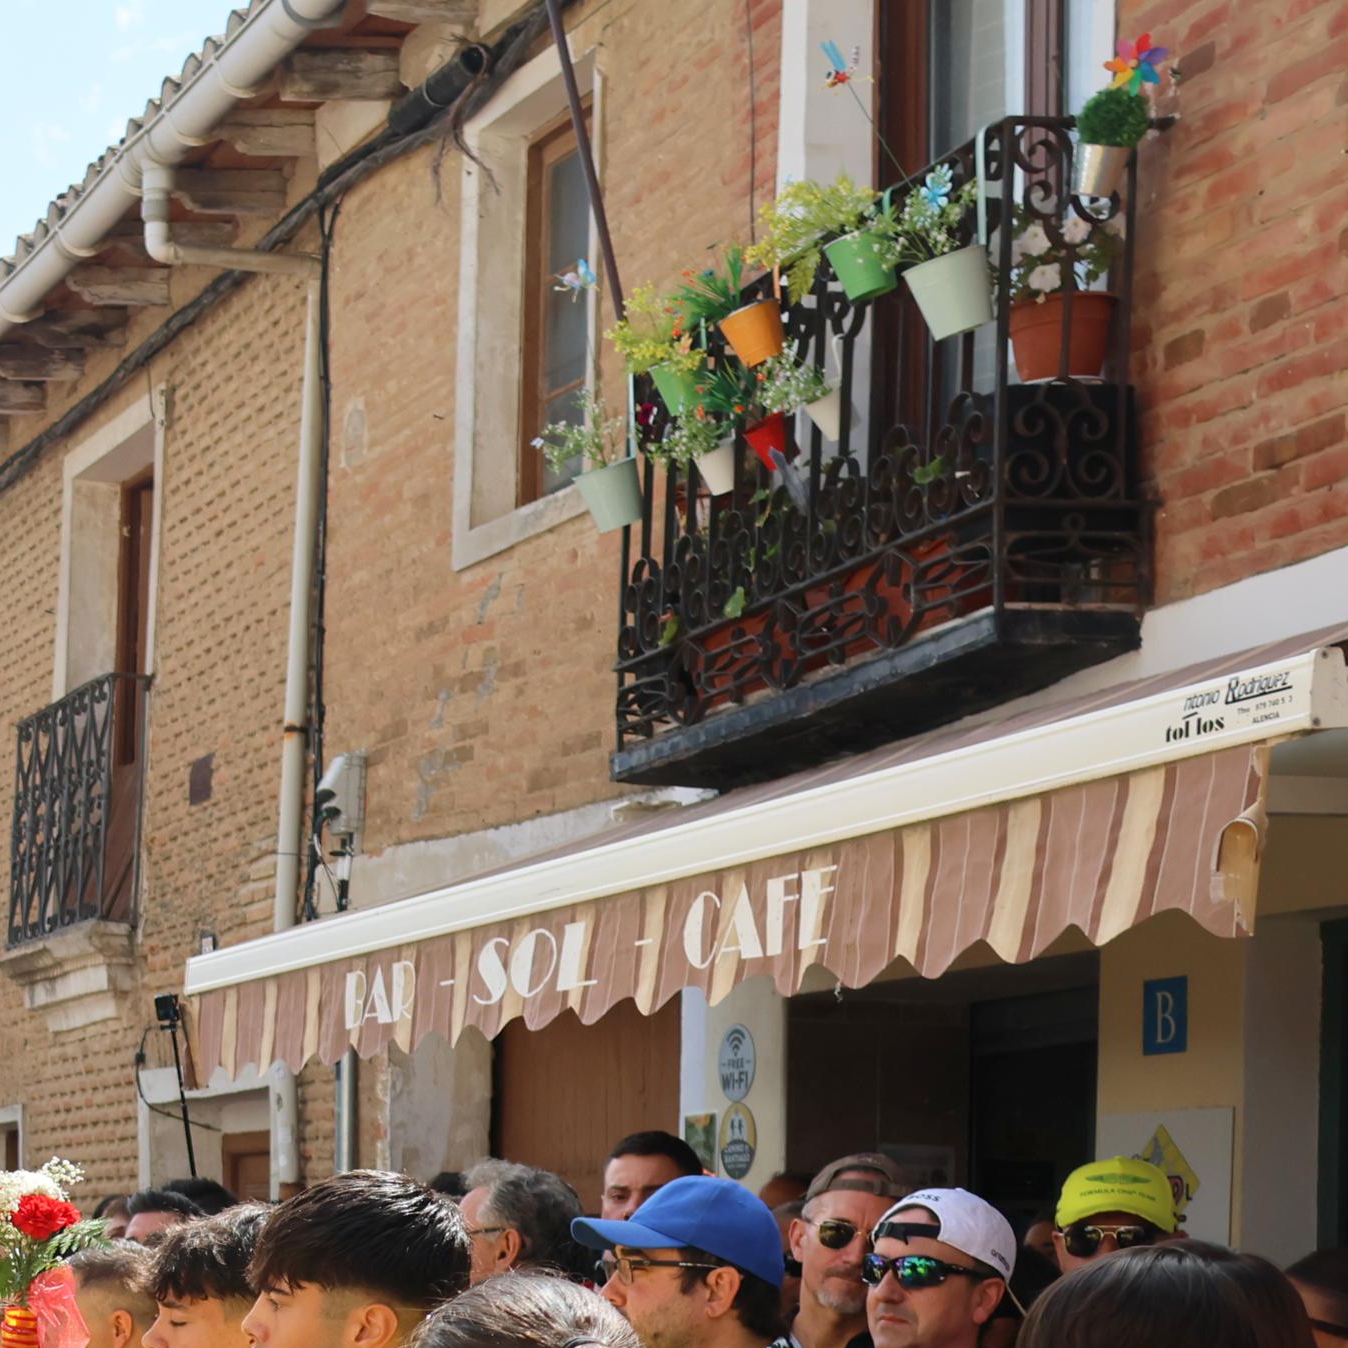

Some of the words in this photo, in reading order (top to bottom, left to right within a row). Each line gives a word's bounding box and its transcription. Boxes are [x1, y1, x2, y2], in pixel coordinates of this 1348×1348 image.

[1184, 690, 1220, 711] ntonio
[1252, 711, 1280, 724] ALENCIA
[345, 960, 416, 1030] BAR
[473, 922, 598, 1005] SOL
[684, 865, 838, 969] CAFE
[1156, 990, 1177, 1043] B
[727, 1058, 745, 1070] FREE
[721, 1071, 749, 1091] WI-FI
